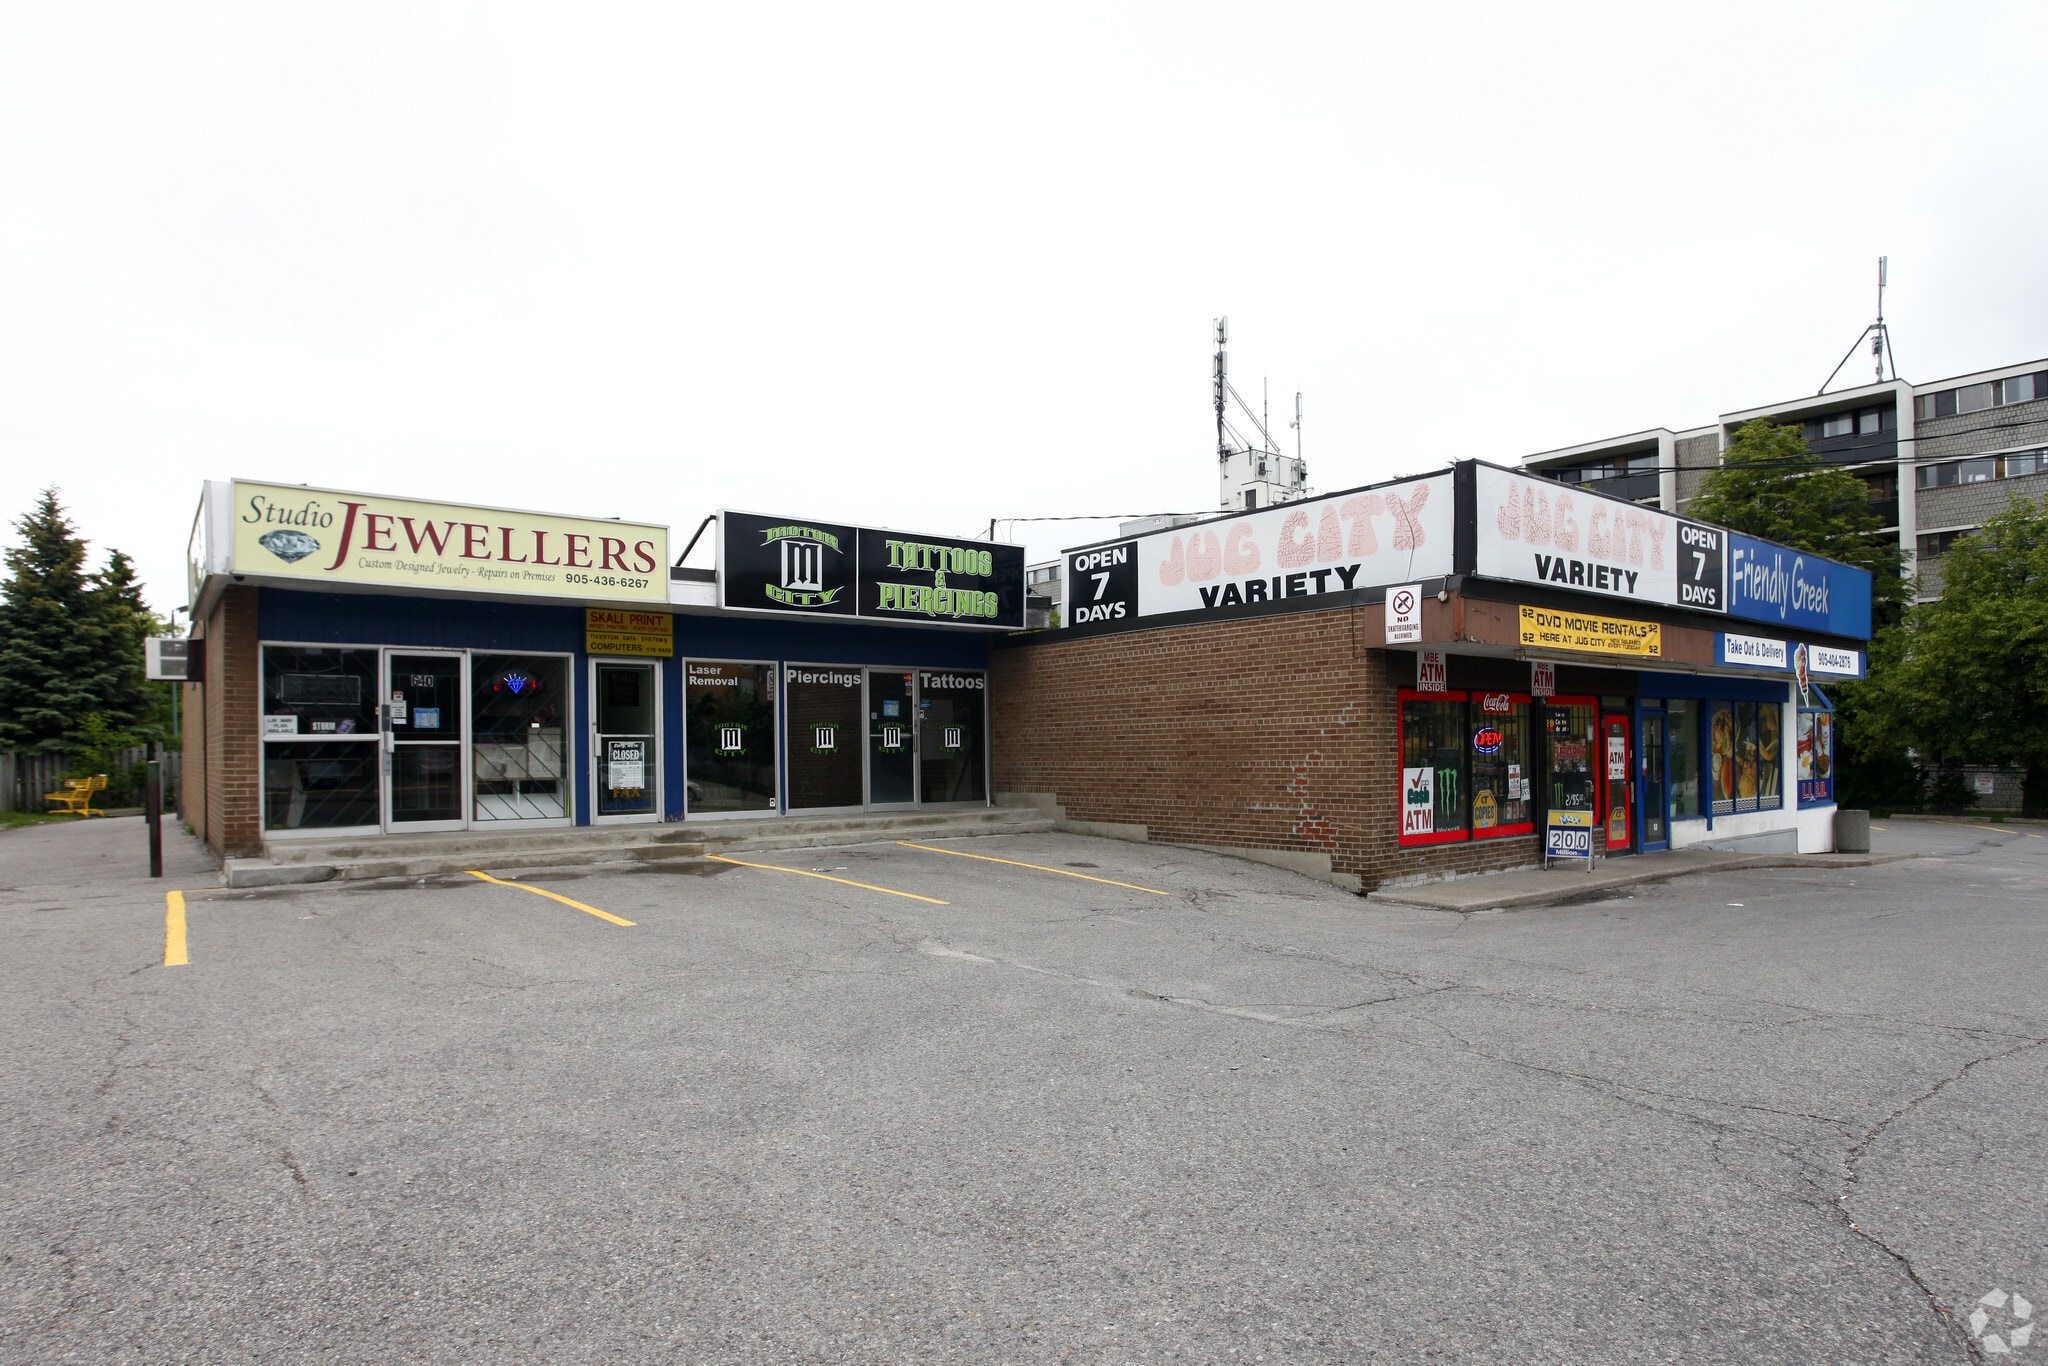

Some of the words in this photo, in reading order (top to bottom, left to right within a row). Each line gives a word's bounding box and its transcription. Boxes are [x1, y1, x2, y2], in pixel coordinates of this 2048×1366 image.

[242, 495, 334, 529] Studio
[1497, 479, 1580, 553] JUG
[1588, 503, 1667, 571] CITY
[323, 501, 656, 573] JEWELLERS
[760, 525, 842, 552] MOTOR
[1159, 522, 1261, 587] JUG
[1276, 482, 1431, 569] CITY
[1681, 526, 1717, 550] OPEN
[885, 539, 994, 577] TATTOOS
[1074, 547, 1128, 572] OPEN
[1692, 552, 1706, 581] 7
[358, 557, 392, 569] Custom
[394, 560, 437, 575] Designed
[436, 563, 469, 579] Jewelry
[477, 567, 508, 580] Repairs
[510, 571, 520, 579] on
[522, 570, 556, 582] Premises
[1534, 553, 1639, 594] VARIETY
[565, 573, 649, 588] 905-436-6267
[1091, 571, 1110, 600] 7
[1199, 564, 1362, 608] VARIETY
[1732, 548, 1789, 619] Friendly
[1791, 556, 1829, 615] Greek
[765, 583, 844, 607] CITY
[876, 582, 998, 618] PIERCINGS
[1682, 583, 1716, 606] DAYS
[590, 612, 623, 624] SKALI
[630, 614, 664, 626] PRINT
[1075, 602, 1126, 624] DAYS
[1522, 608, 1534, 618] $2
[1387, 623, 1419, 632] SKATEBOARDING
[1536, 613, 1561, 628] DVD
[1565, 617, 1599, 633] MOVIE
[1601, 622, 1647, 637] RENTALS
[1648, 624, 1658, 633] $2
[1522, 632, 1535, 642] $2
[1539, 632, 1560, 643] HERE
[1562, 635, 1572, 644] AT
[1574, 636, 1588, 646] JUG
[1590, 637, 1606, 647] CITY
[590, 642, 643, 652] COMPUTERS
[1648, 645, 1658, 654] $2
[1727, 638, 1742, 654] Take
[1743, 640, 1755, 656] Out
[1755, 642, 1760, 656] &
[1762, 643, 1784, 662] Delivery
[1424, 652, 1440, 663] MBE
[689, 665, 722, 675] Laser
[1420, 663, 1445, 682] ATM
[411, 675, 434, 687] 640
[689, 676, 738, 686] Removal
[787, 670, 862, 688] Piercings
[920, 672, 984, 689] Tattoos
[1419, 682, 1445, 692] INSIDE
[1533, 671, 1553, 687] ATM
[1533, 687, 1553, 696] INSIDE
[312, 721, 336, 731] STORM
[1477, 732, 1503, 746] OPEN
[612, 749, 640, 760] CLOSED
[714, 748, 747, 757] CITY
[1609, 751, 1624, 764] ATM
[613, 787, 641, 798] FAX
[1405, 808, 1432, 831] ATM
[1475, 805, 1494, 820] COPIES
